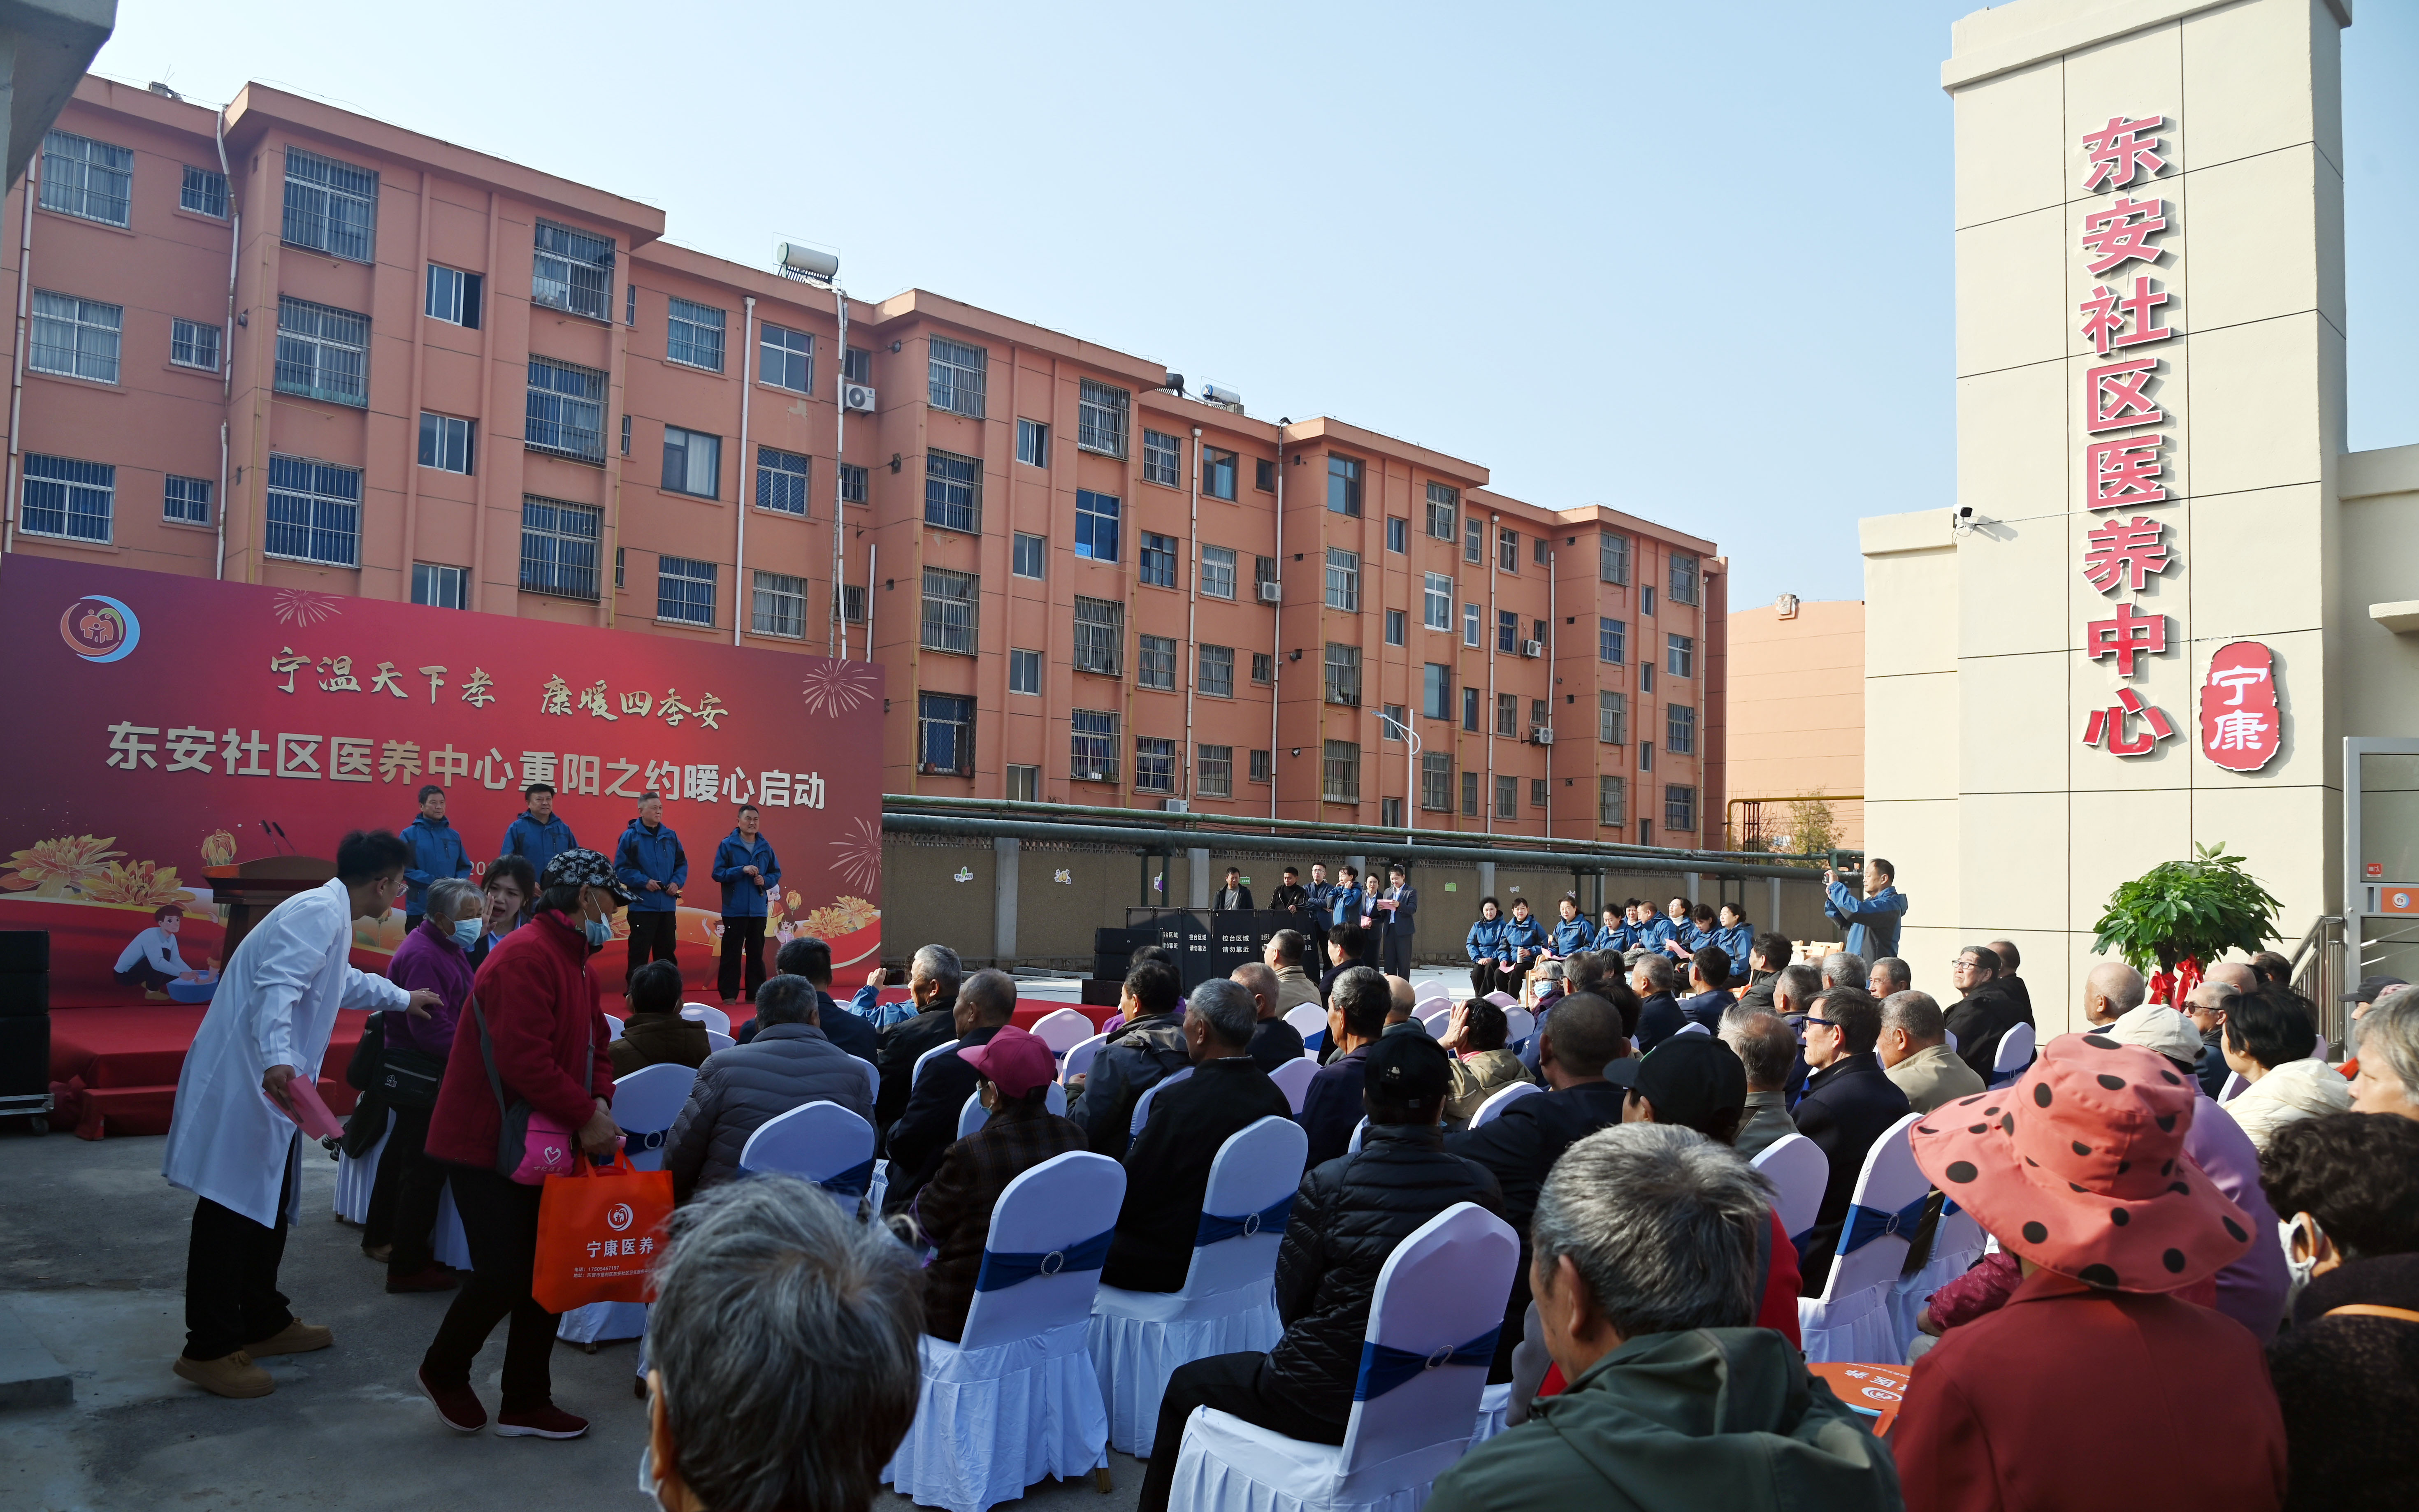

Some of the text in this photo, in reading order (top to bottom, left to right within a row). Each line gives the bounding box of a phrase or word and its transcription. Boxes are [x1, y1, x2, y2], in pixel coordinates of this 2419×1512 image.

[2079, 114, 2175, 756] 东安社区医养中心
[271, 646, 728, 729] 宁温天下孝 康暖四季安
[2210, 665, 2269, 750] 宁康
[106, 721, 825, 809] 东安社区医养中心重阳之约暖心启动
[470, 861, 492, 875] 20
[586, 1236, 654, 1258] 宁康医养
